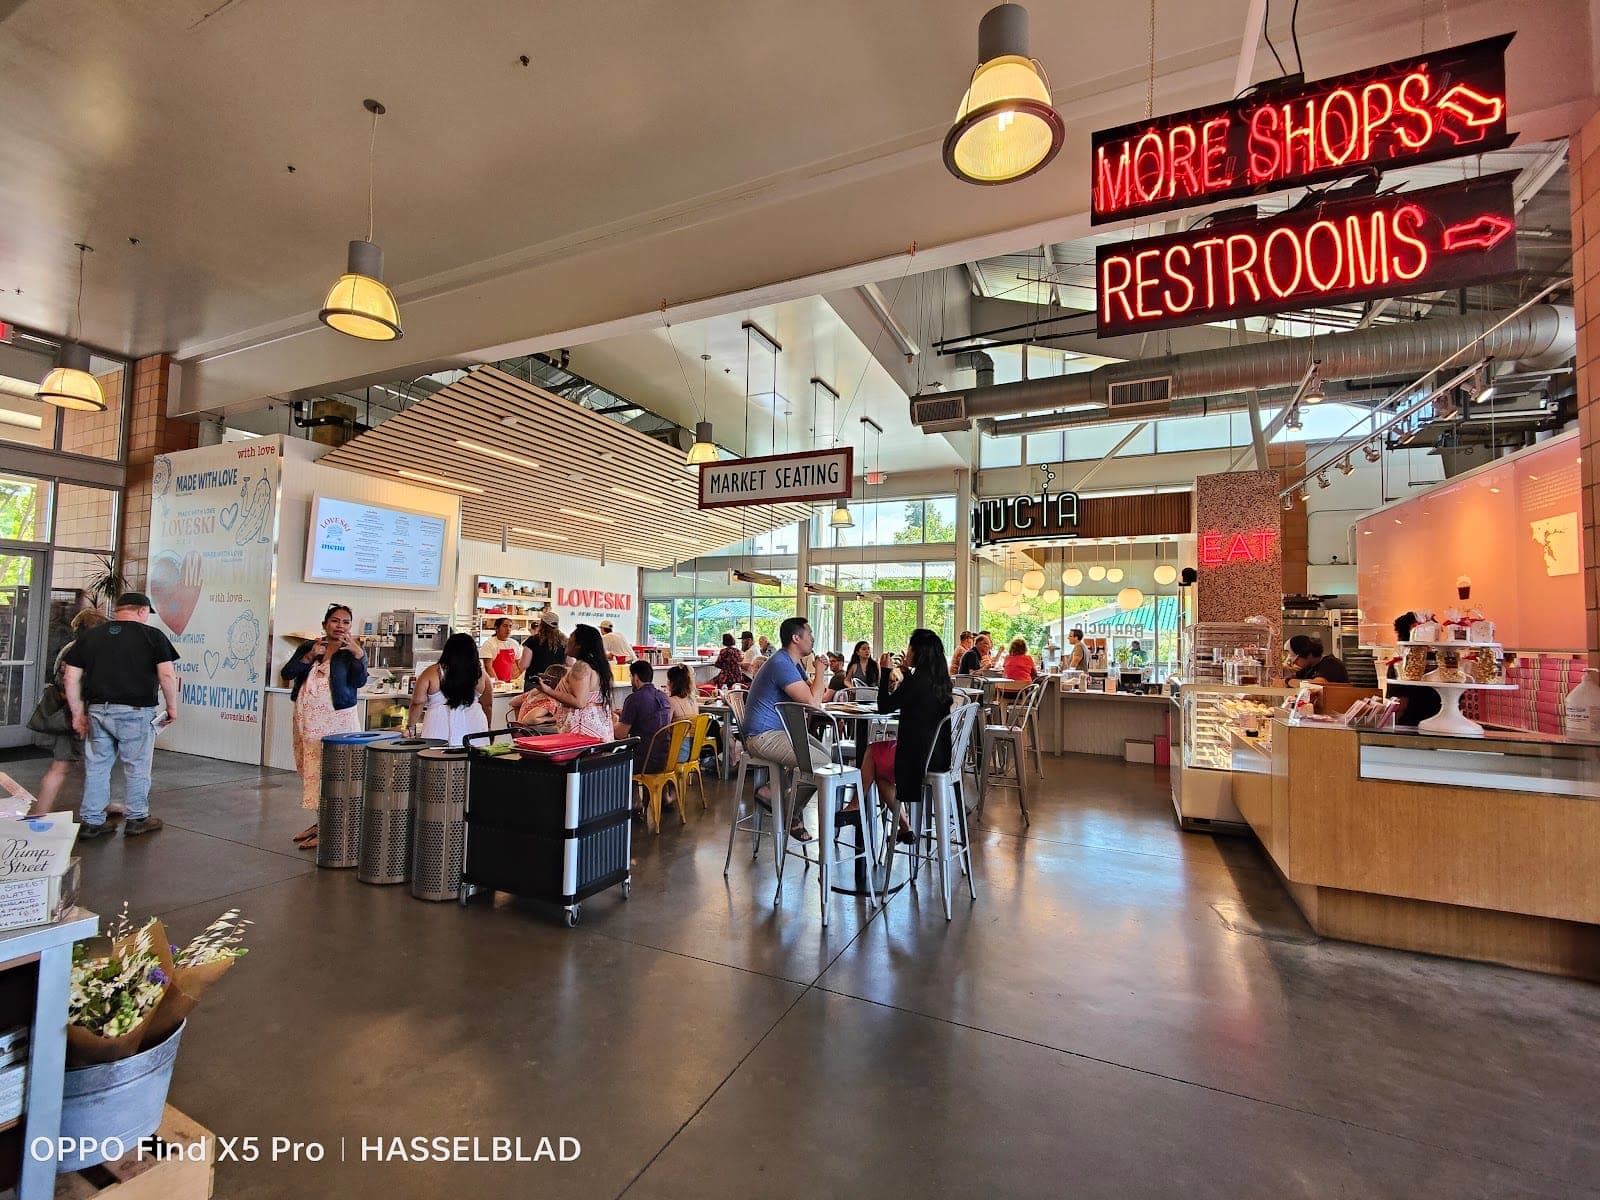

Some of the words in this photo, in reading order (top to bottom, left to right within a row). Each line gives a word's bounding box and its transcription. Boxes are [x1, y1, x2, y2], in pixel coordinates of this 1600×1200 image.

[1097, 118, 1231, 214] MORE
[1248, 71, 1434, 178] SHOPS
[1103, 205, 1429, 324] RESTROOMS
[238, 447, 256, 459] with
[257, 445, 276, 456] love
[176, 474, 196, 492] MADE
[198, 471, 217, 489] WITH
[219, 468, 238, 487] LOVE
[710, 469, 767, 494] MARKET
[775, 462, 839, 489] SEATING
[160, 516, 215, 537] LOVESKI
[321, 543, 345, 552] menu
[1203, 531, 1277, 564] EAT
[209, 592, 225, 602] with
[557, 587, 632, 611] LOVESKI
[182, 662, 200, 673] LOVE
[182, 683, 208, 706] MADE
[209, 685, 233, 709] WITH
[234, 687, 259, 712] LOVE
[2, 838, 57, 863] Pump
[0, 857, 50, 877] Street
